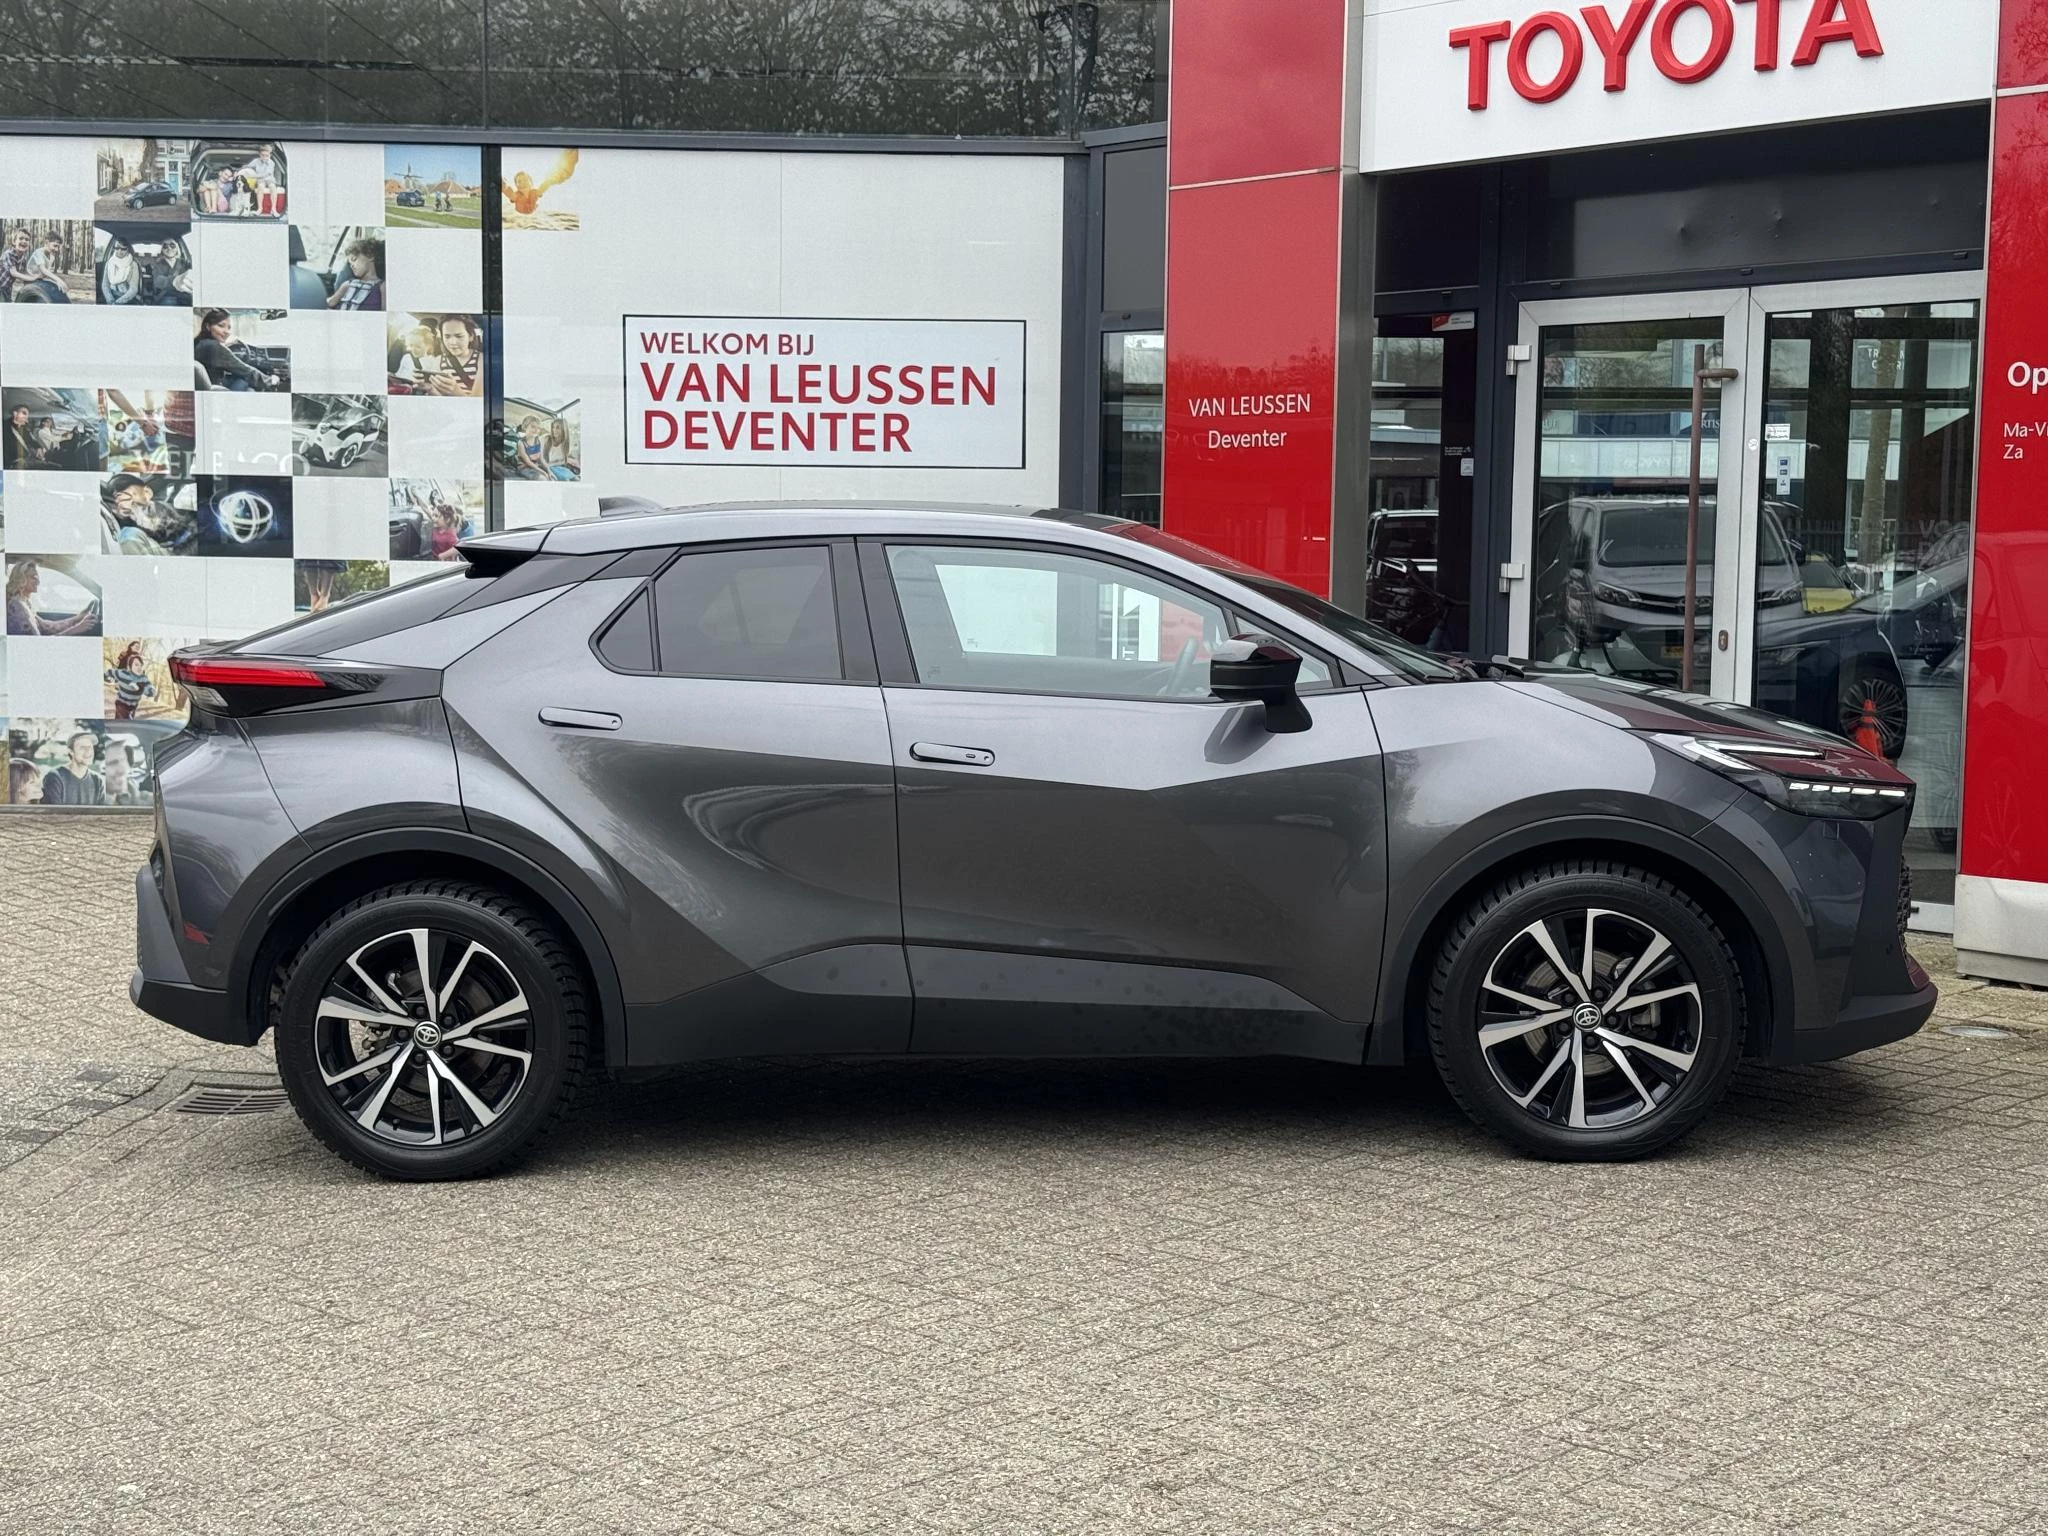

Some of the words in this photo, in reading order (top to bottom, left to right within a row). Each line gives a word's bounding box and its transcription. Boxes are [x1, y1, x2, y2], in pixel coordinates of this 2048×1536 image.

[1449, 0, 1884, 110] TOYOTA
[640, 332, 769, 355] WELKOM
[778, 334, 815, 357] BIJ
[640, 362, 751, 402] VAN
[769, 364, 996, 406] LEUSSEN
[1188, 397, 1225, 417] VAN
[1230, 393, 1311, 416] LEUSSEN
[644, 409, 913, 453] DEVENTER
[1208, 429, 1288, 449] Deventer
[2003, 444, 2024, 460] Za
